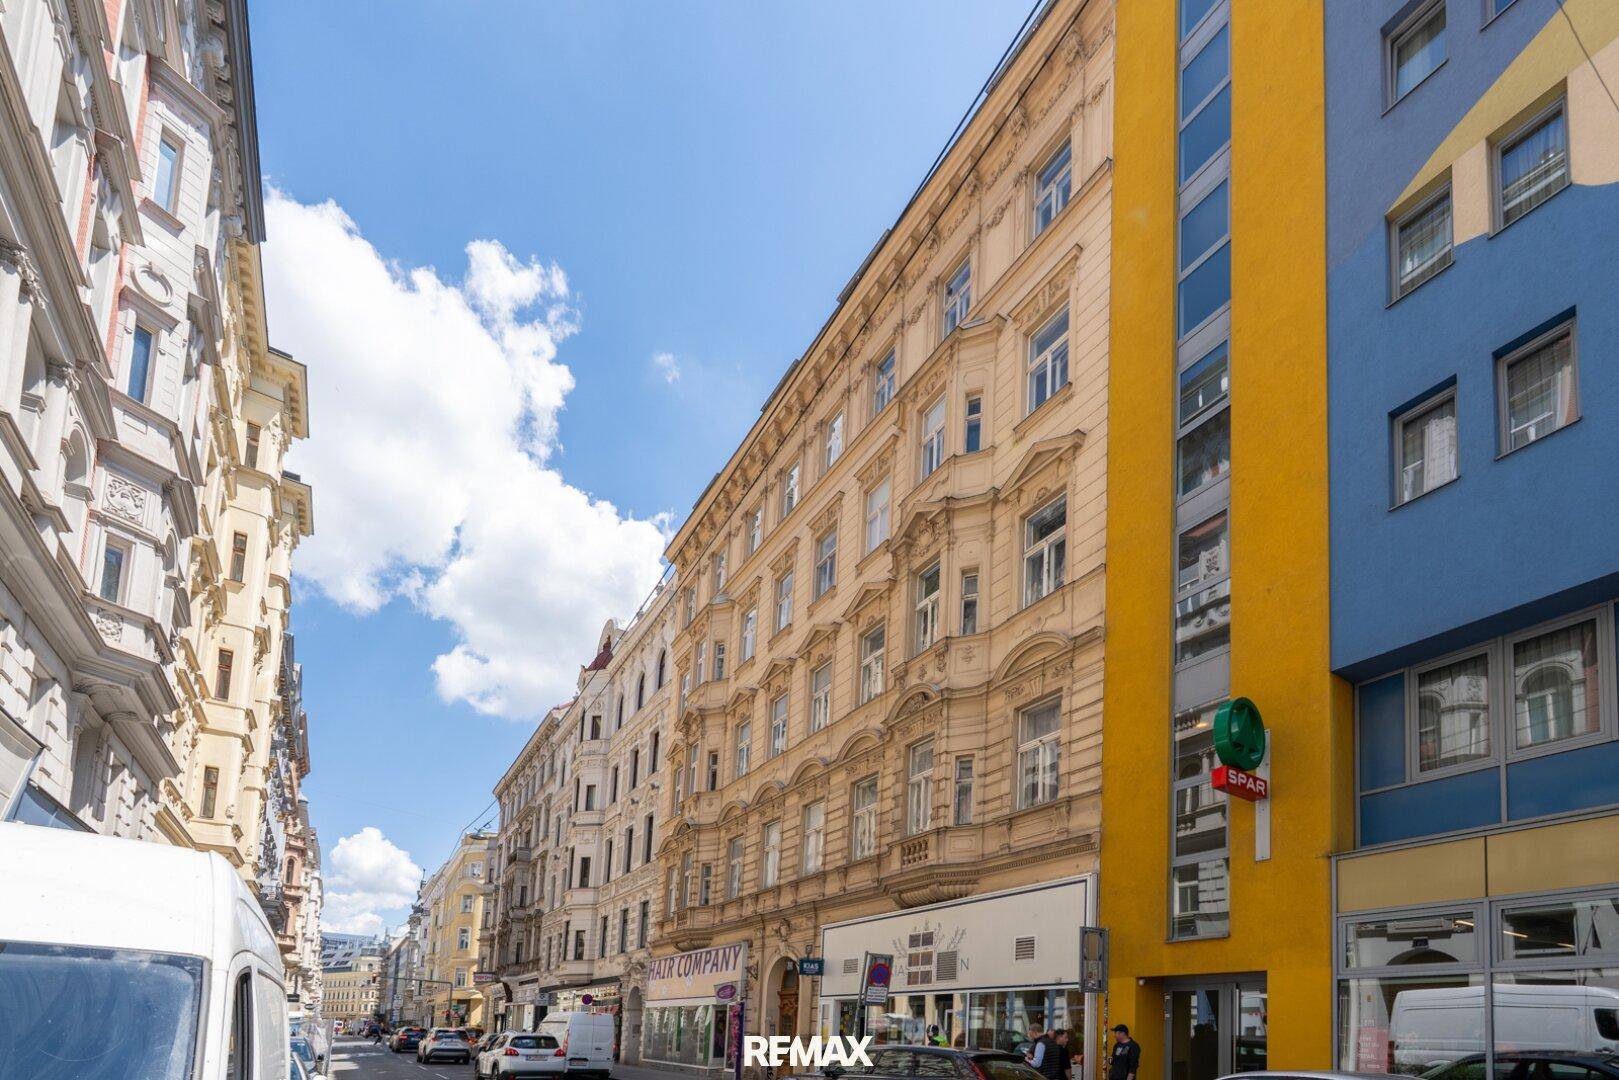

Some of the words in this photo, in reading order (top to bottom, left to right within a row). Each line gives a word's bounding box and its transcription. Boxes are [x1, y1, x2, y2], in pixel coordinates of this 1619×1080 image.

[1228, 769, 1266, 795] SPAR
[648, 956, 675, 981] HAIR
[677, 945, 742, 978] COMPANY
